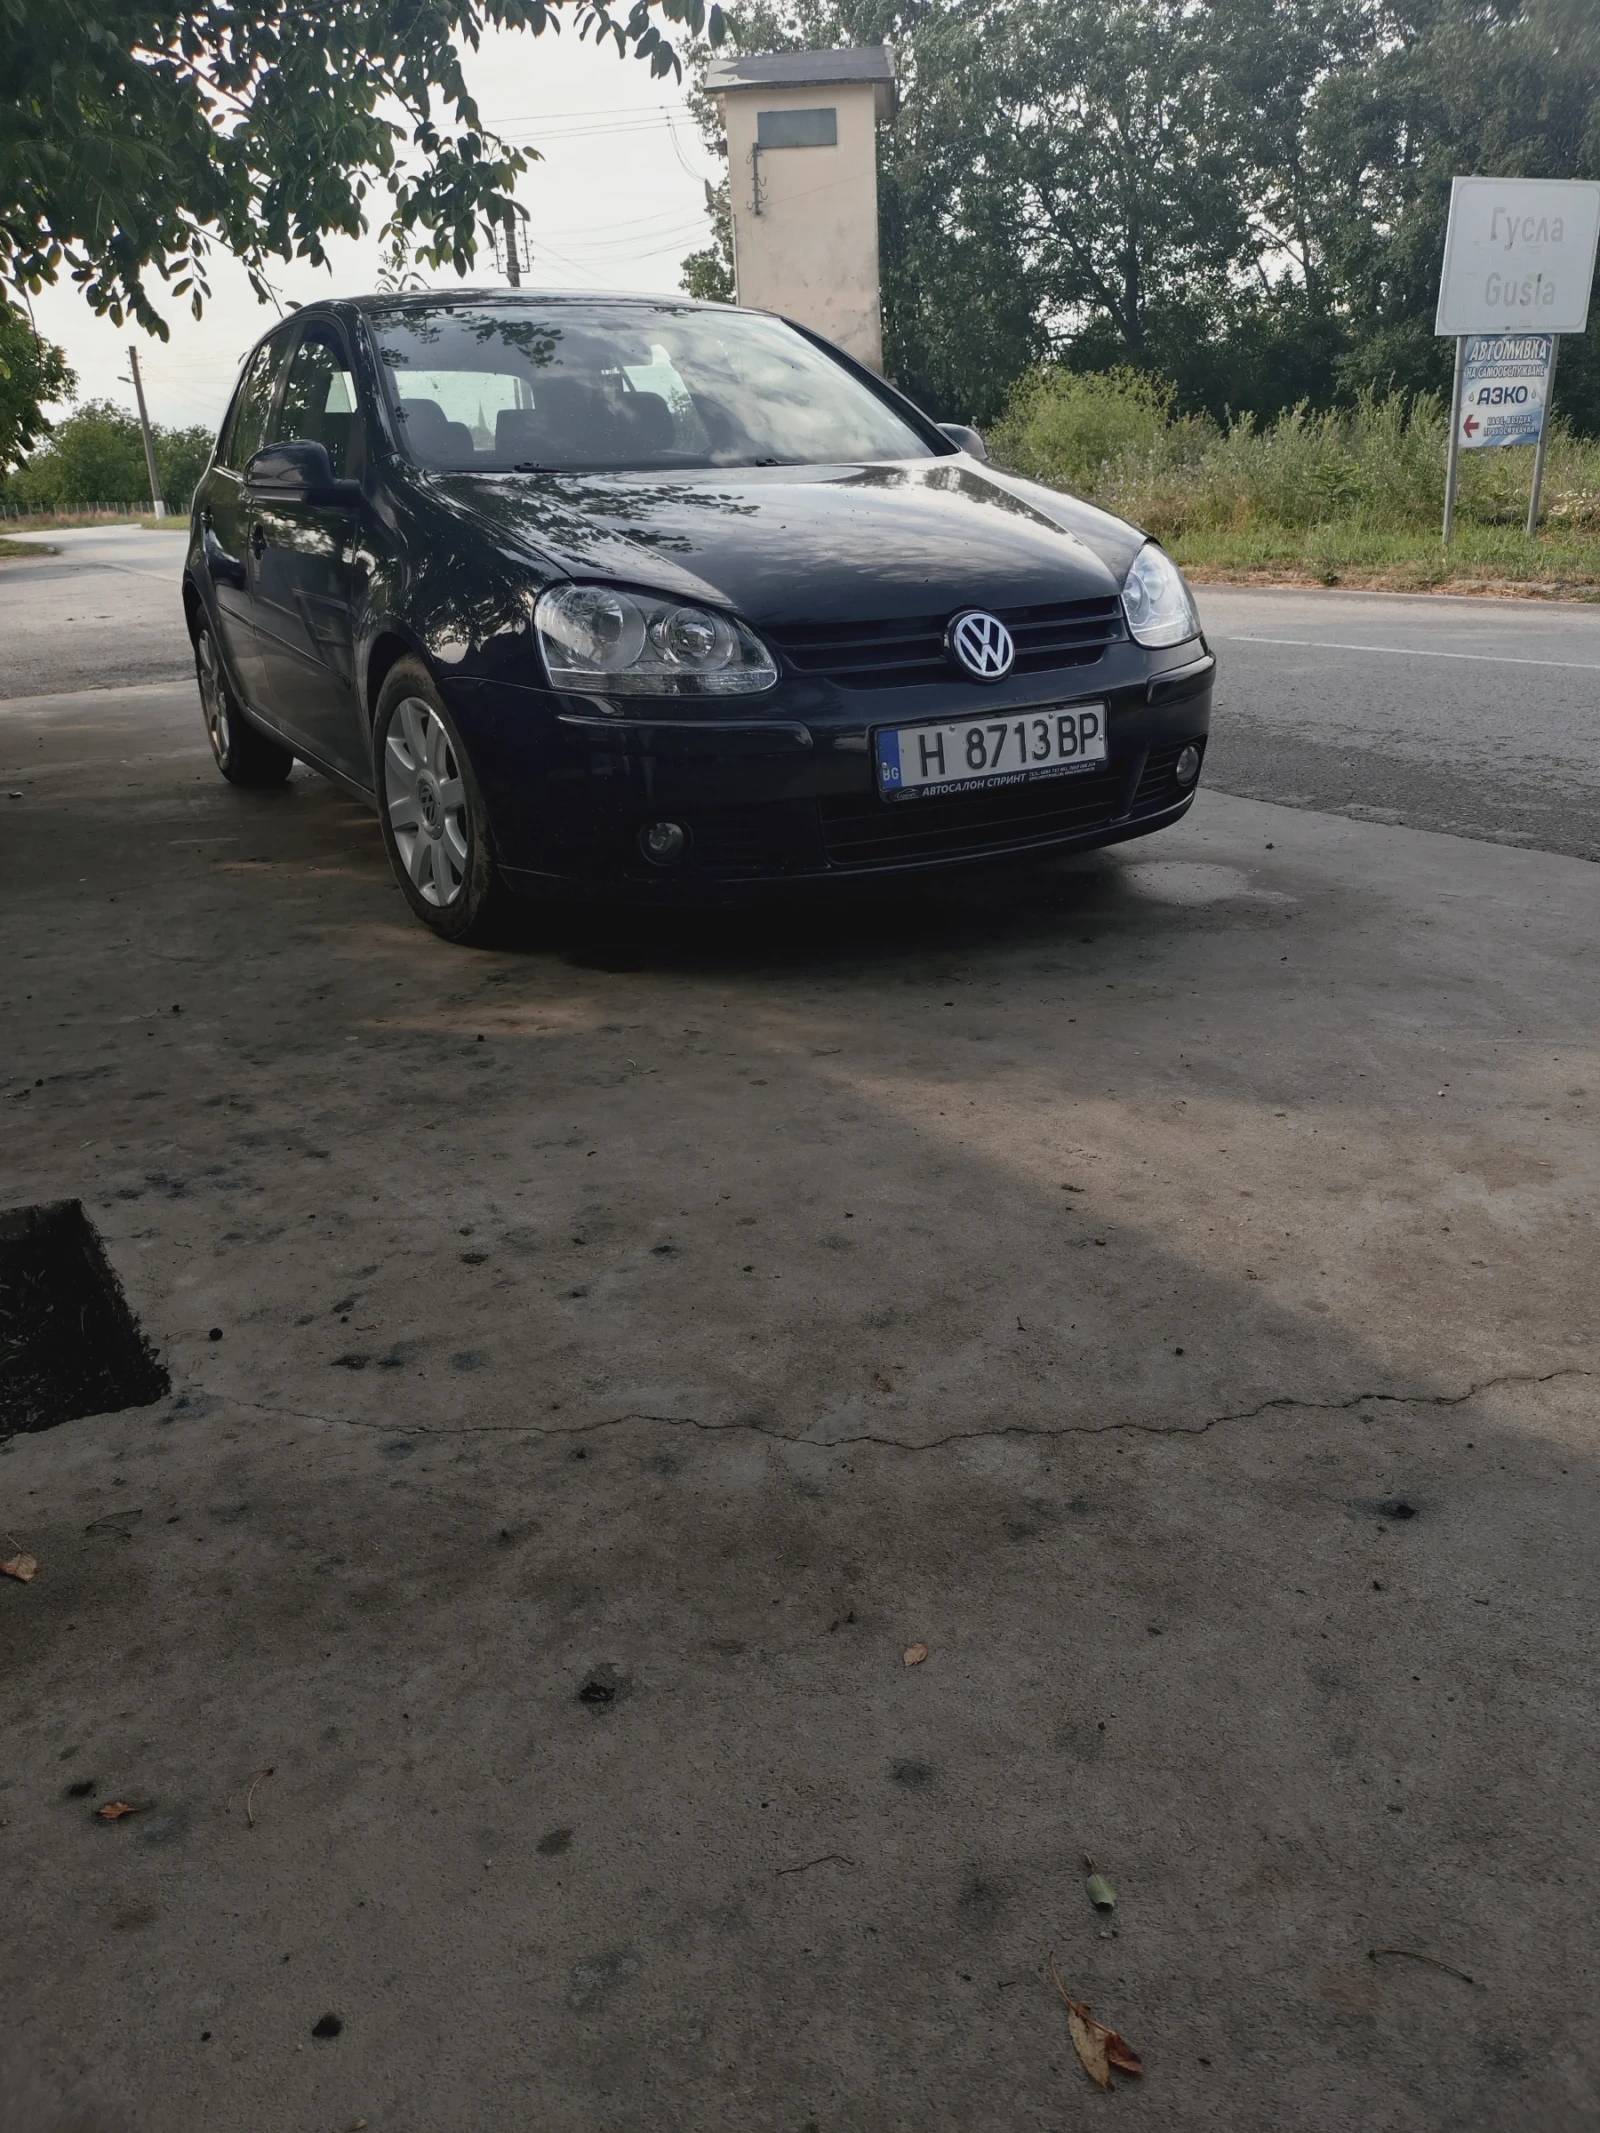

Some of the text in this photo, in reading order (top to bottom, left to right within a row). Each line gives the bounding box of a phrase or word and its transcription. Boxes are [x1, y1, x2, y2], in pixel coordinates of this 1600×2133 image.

[1490, 206, 1565, 251] Гусла
[1485, 272, 1556, 307] Gusla
[1469, 339, 1547, 361] АВТОМИВКА
[1466, 364, 1545, 379] НА САМООБСЛУЖВАНЕ
[1476, 386, 1529, 405] АЗКО
[955, 613, 1014, 677] VW
[882, 767, 900, 781] BG
[922, 780, 984, 796] АВТОСАЛОН
[987, 773, 1027, 787] СПРИНТ
